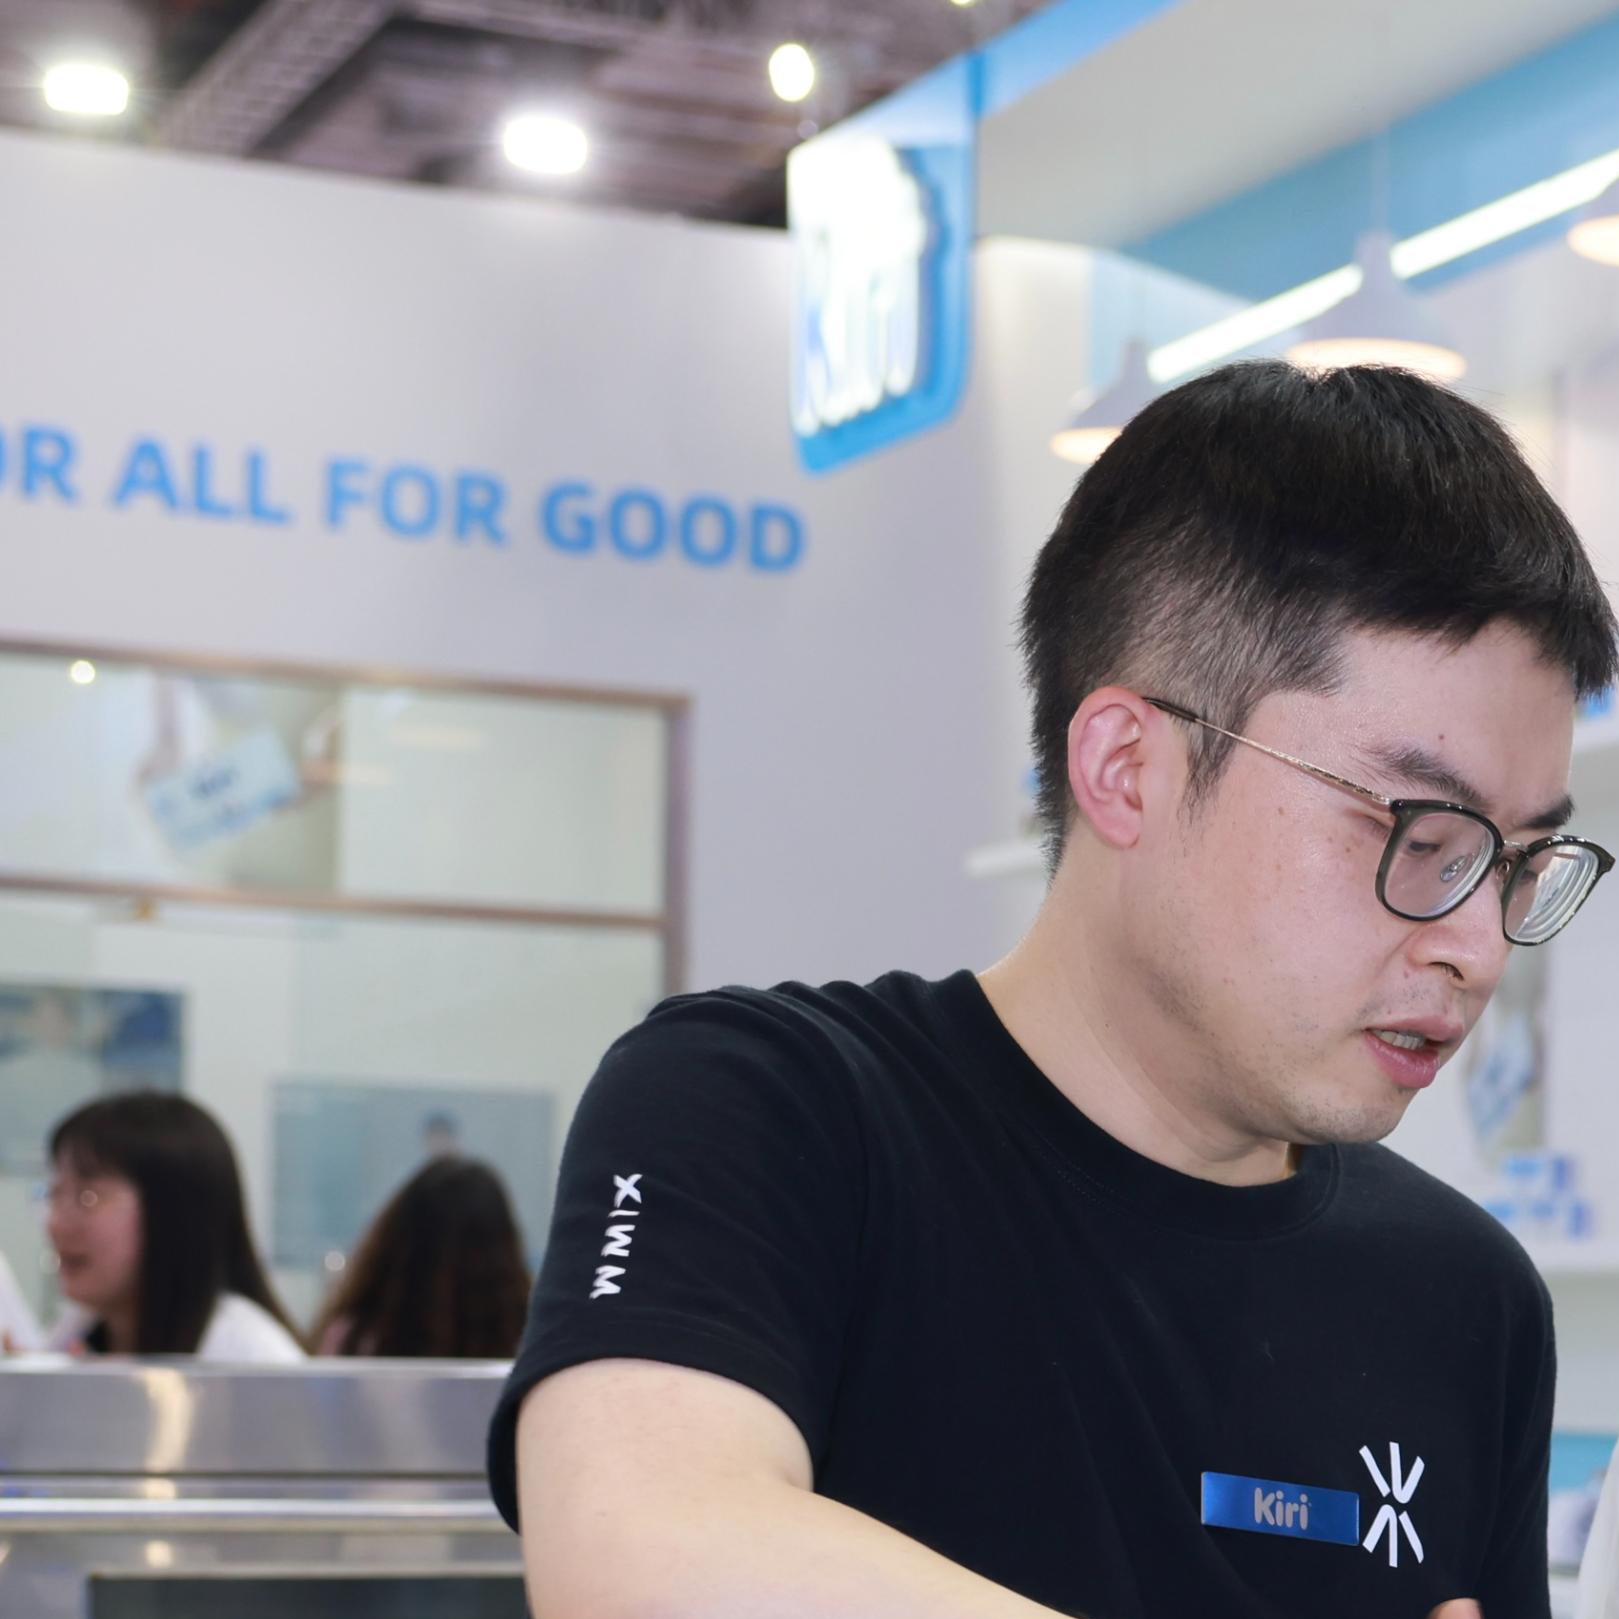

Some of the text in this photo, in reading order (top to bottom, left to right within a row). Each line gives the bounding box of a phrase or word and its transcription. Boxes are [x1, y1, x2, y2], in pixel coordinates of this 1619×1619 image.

[0, 424, 806, 574] R ALL FOR GOOD
[589, 1174, 643, 1299] WMIX
[1254, 1487, 1309, 1531] Kiri
